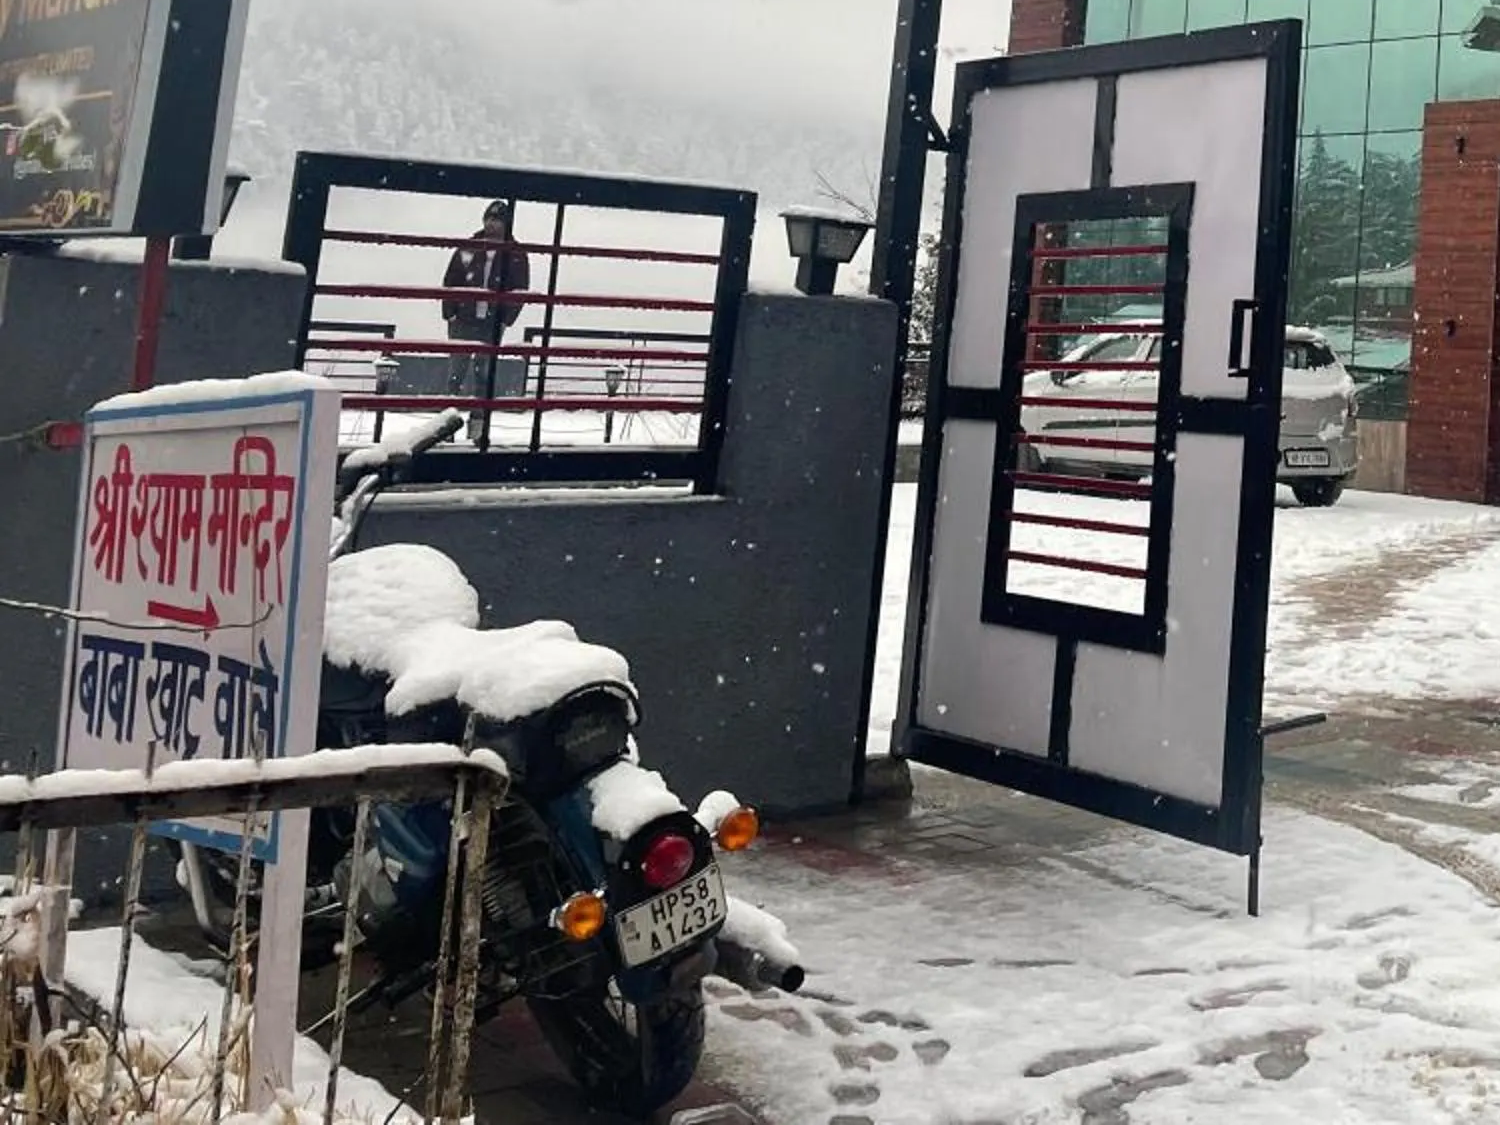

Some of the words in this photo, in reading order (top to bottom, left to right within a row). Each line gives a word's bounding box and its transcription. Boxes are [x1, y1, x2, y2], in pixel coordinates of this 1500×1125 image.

[90, 443, 134, 583] श्री
[131, 473, 205, 592] श्याम
[79, 634, 146, 742] बाबा
[214, 638, 280, 760] वाले
[651, 878, 709, 924] HP58
